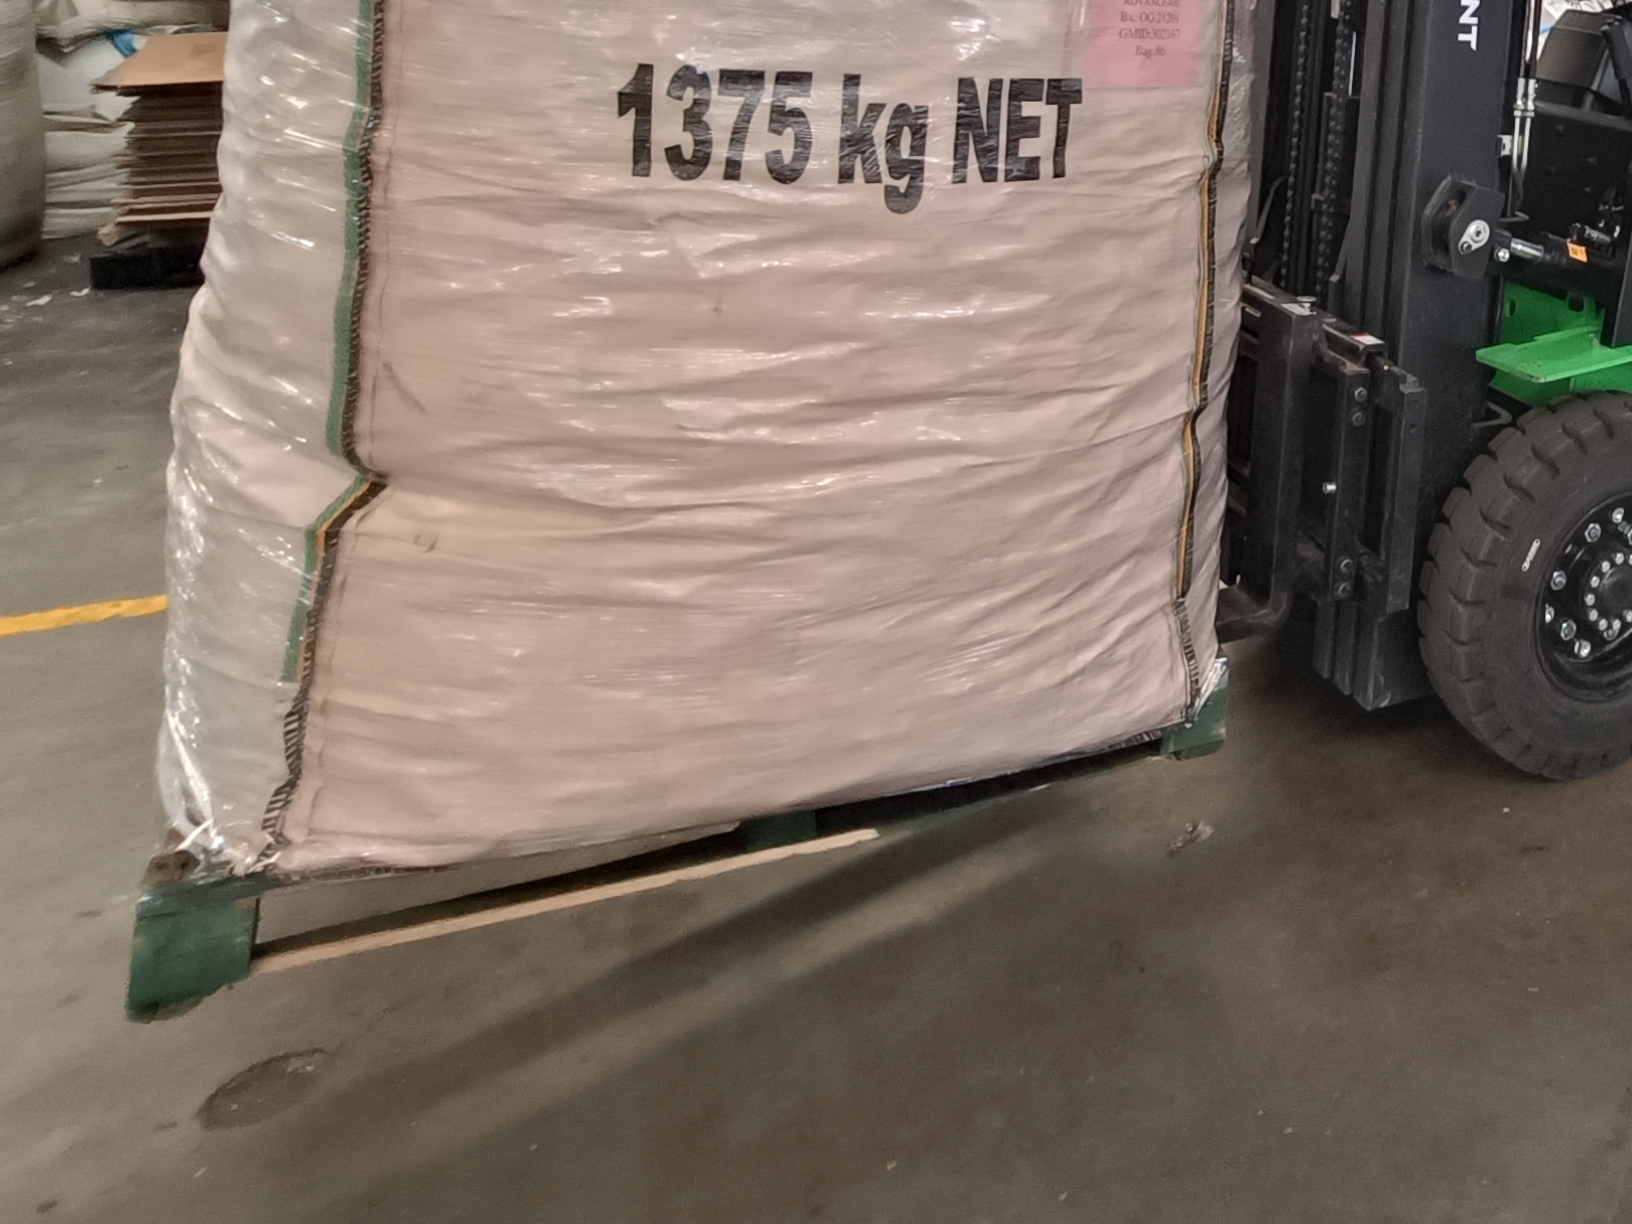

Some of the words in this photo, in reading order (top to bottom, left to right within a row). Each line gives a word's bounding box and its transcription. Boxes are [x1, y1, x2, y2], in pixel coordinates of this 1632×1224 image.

[617, 63, 813, 184] 1375
[838, 74, 928, 214] kg
[952, 77, 1083, 184] NET
